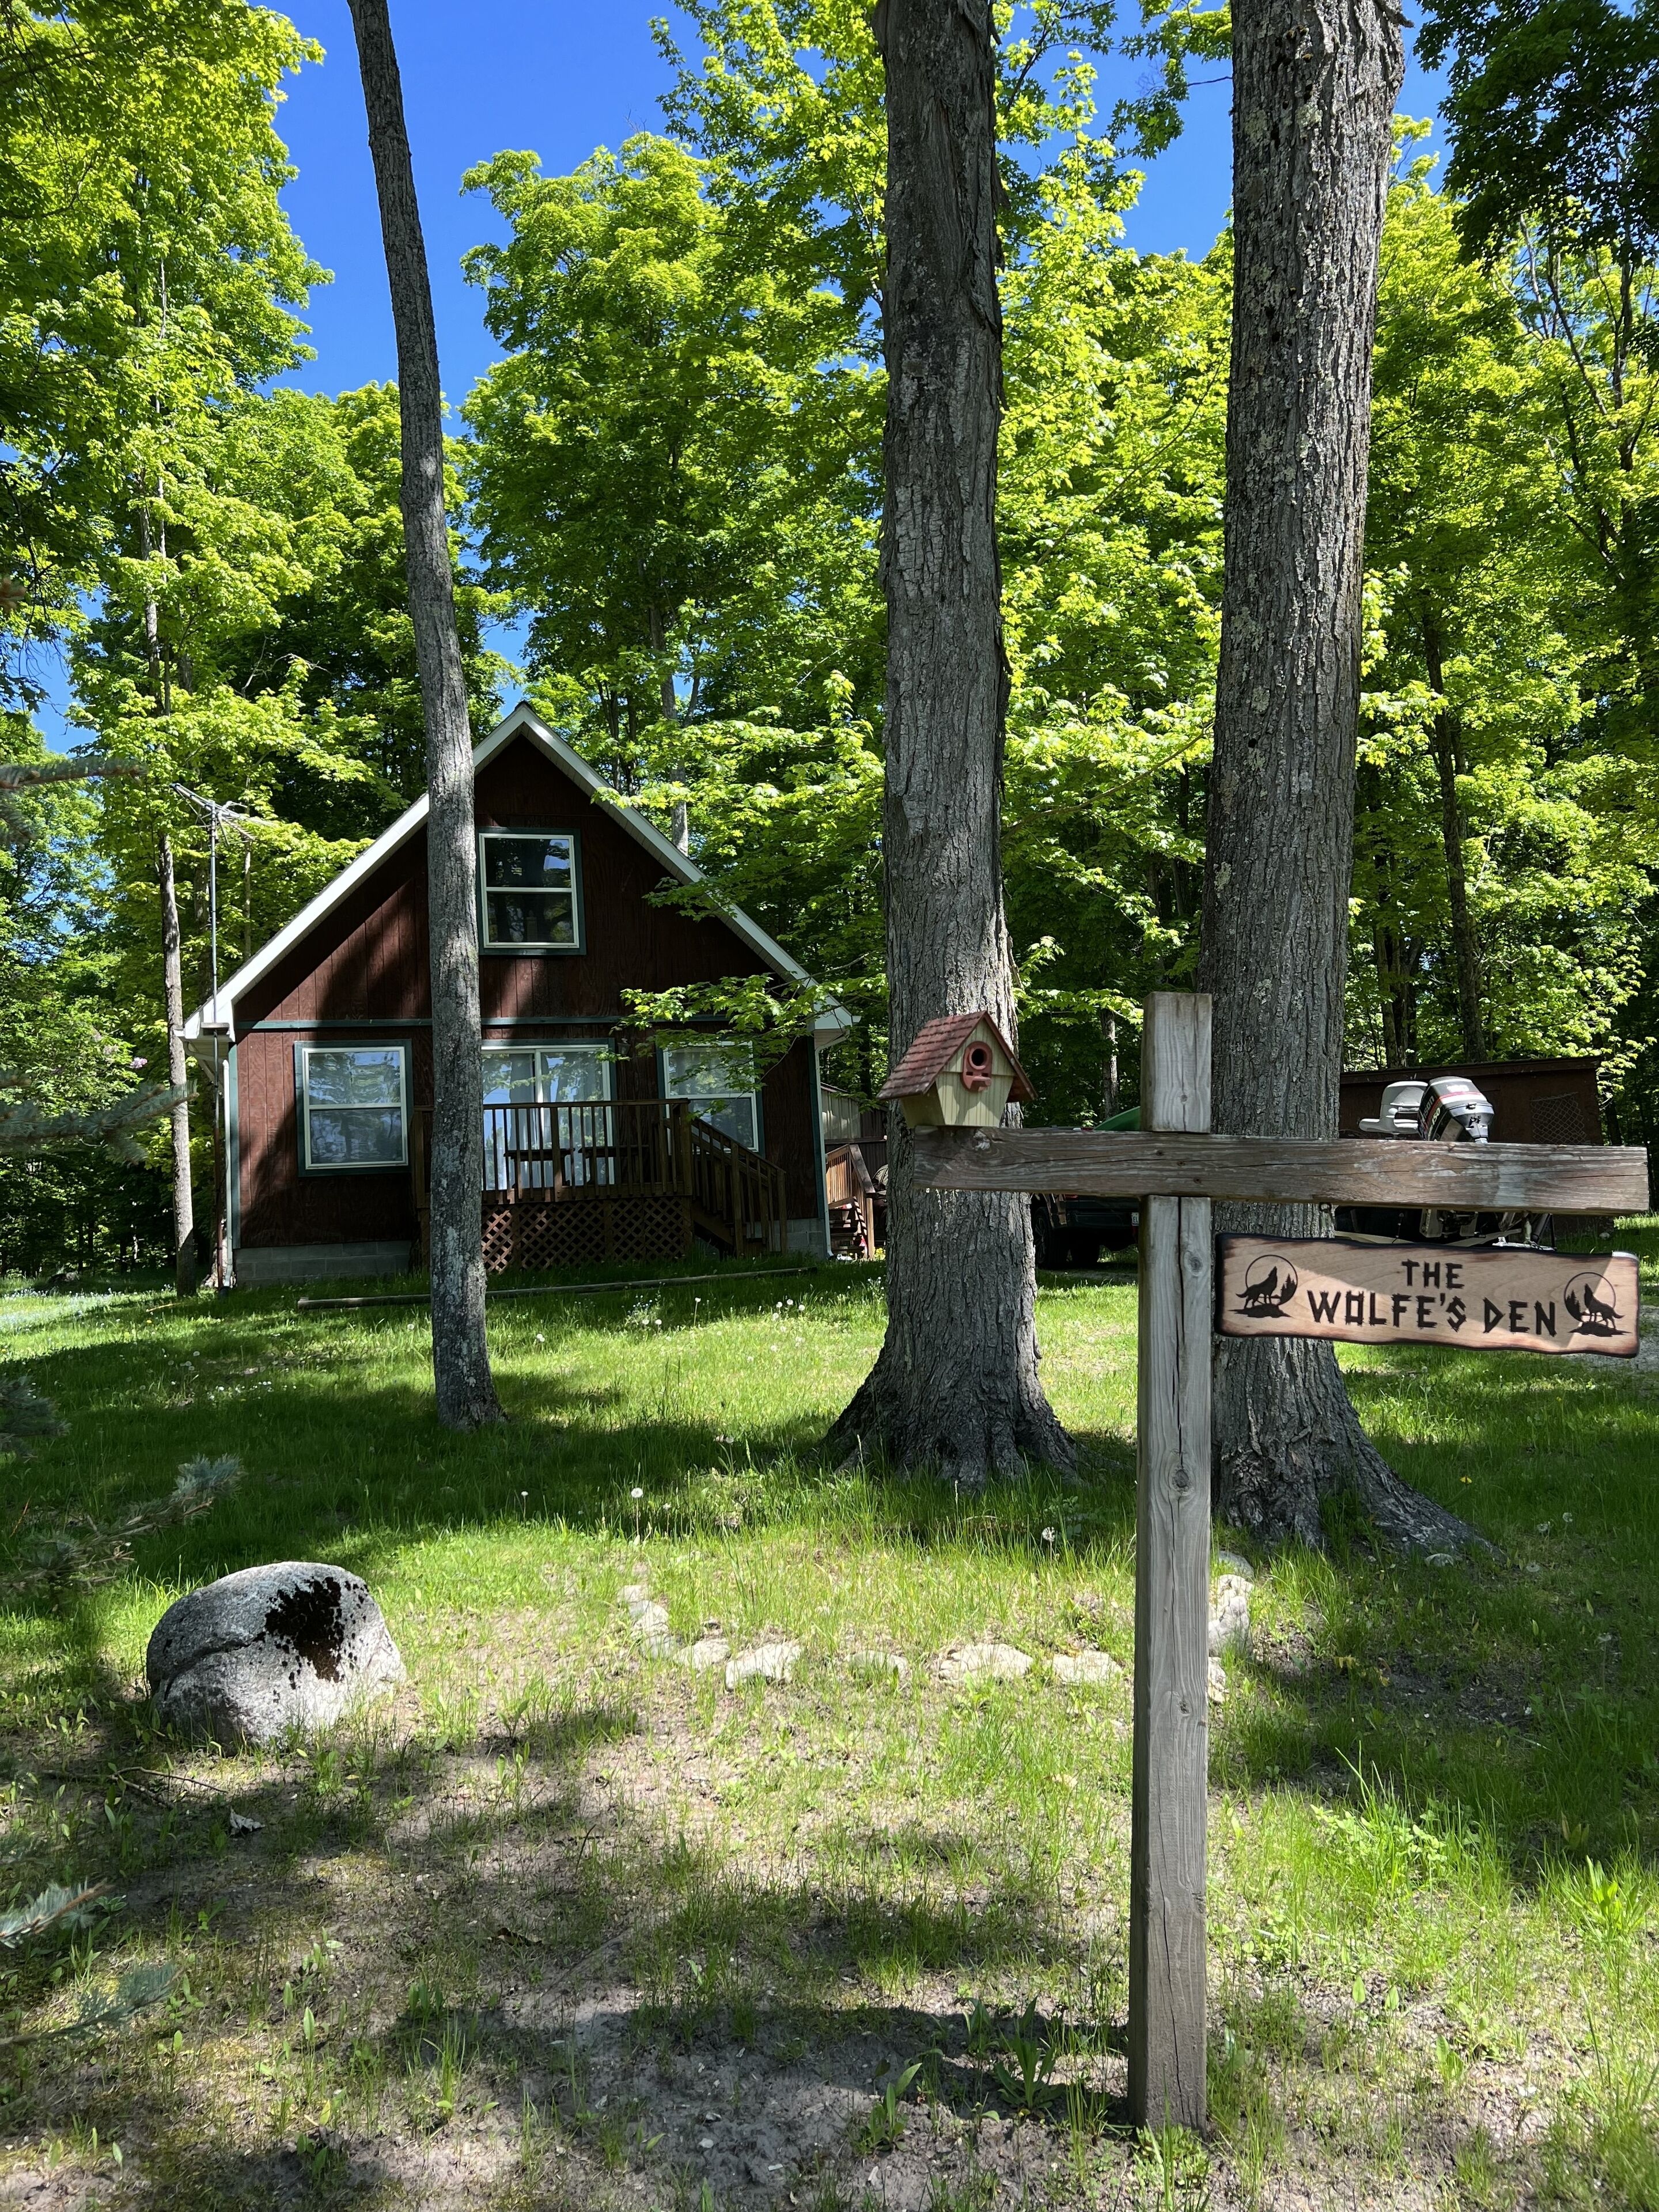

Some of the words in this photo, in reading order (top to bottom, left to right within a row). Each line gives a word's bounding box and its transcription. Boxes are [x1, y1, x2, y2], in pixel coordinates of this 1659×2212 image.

[1432, 1107, 1440, 1126] 150
[1401, 1259, 1465, 1289] THE
[1307, 1290, 1467, 1332] WOLFE'S
[1483, 1297, 1557, 1337] DEN
